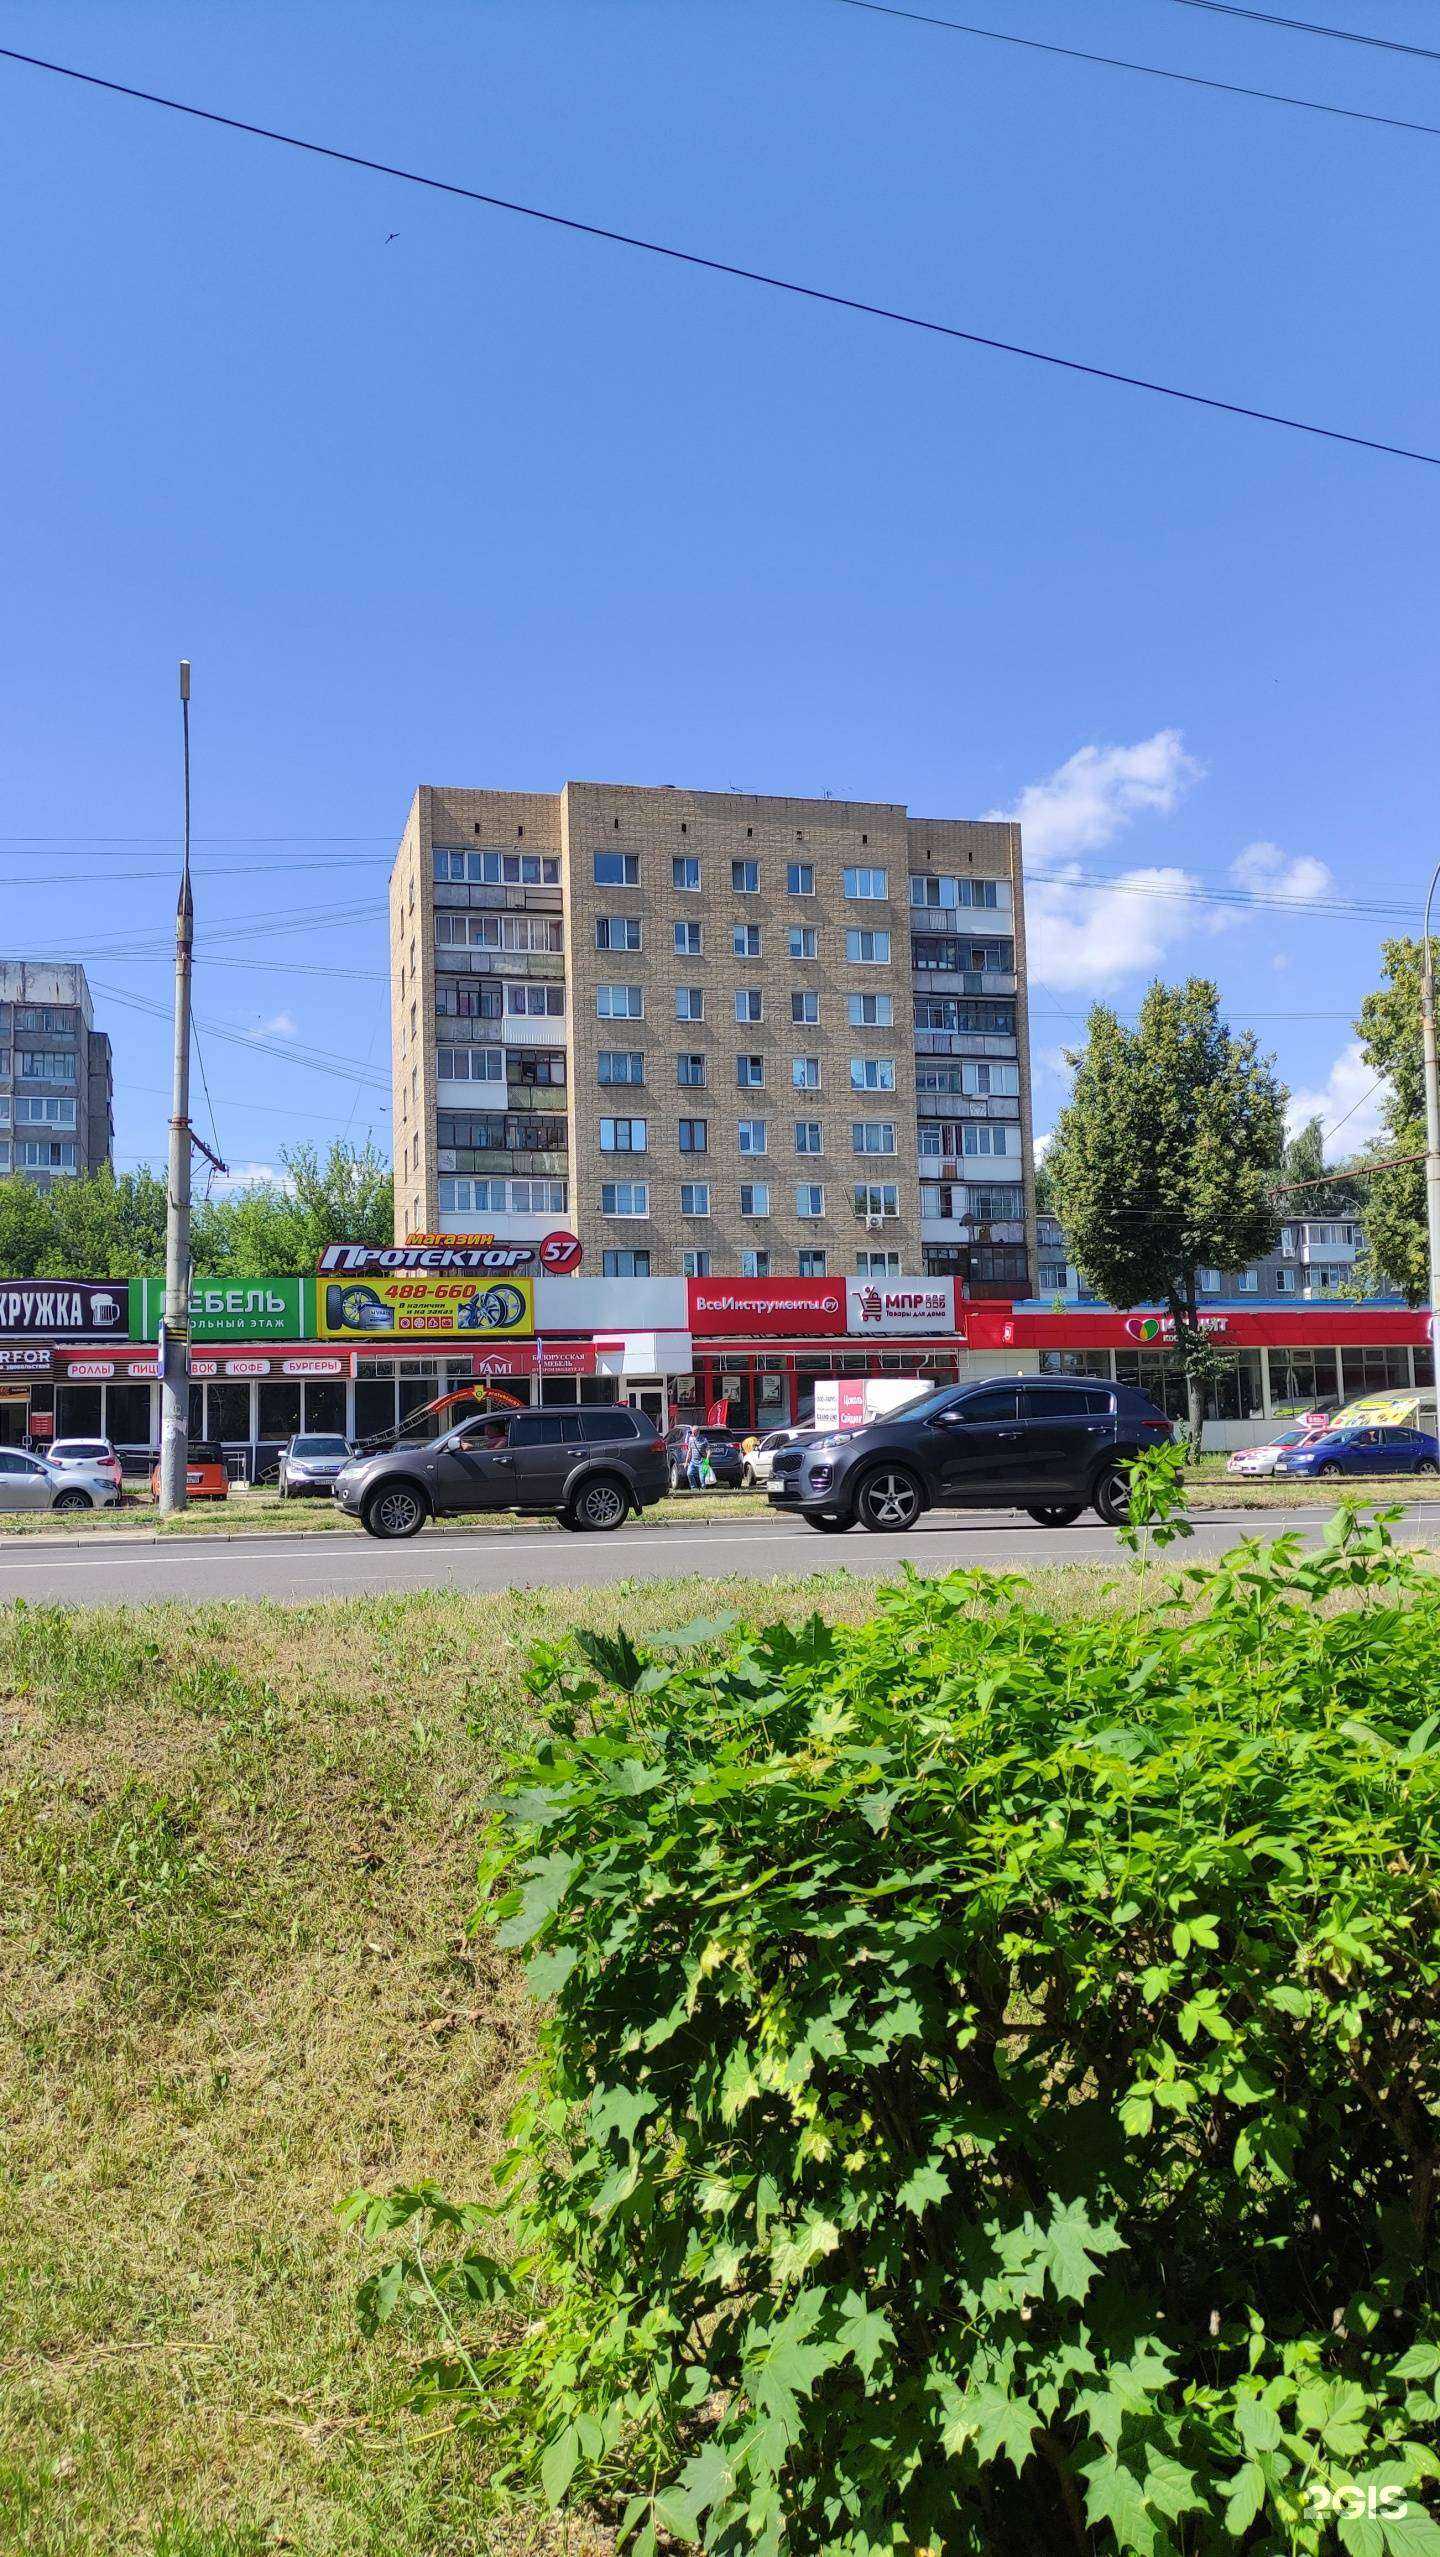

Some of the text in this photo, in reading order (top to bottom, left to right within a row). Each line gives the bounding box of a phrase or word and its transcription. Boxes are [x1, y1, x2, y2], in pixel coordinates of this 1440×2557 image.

[405, 1233, 494, 1246] магазин
[543, 1242, 576, 1261] 57
[384, 1284, 478, 1299] 488-660
[160, 1290, 286, 1313] ЕБЕЛЬ
[886, 1294, 924, 1309] МПР
[886, 1310, 912, 1318] Товары
[250, 1319, 285, 1328] ЭТАЖ
[71, 1365, 111, 1375] РОЛЛЫ
[191, 1363, 214, 1373] ВОК
[233, 1363, 264, 1372] КОФЕ
[289, 1362, 337, 1371] БУРГЕРЫ
[482, 1363, 512, 1374] AMI
